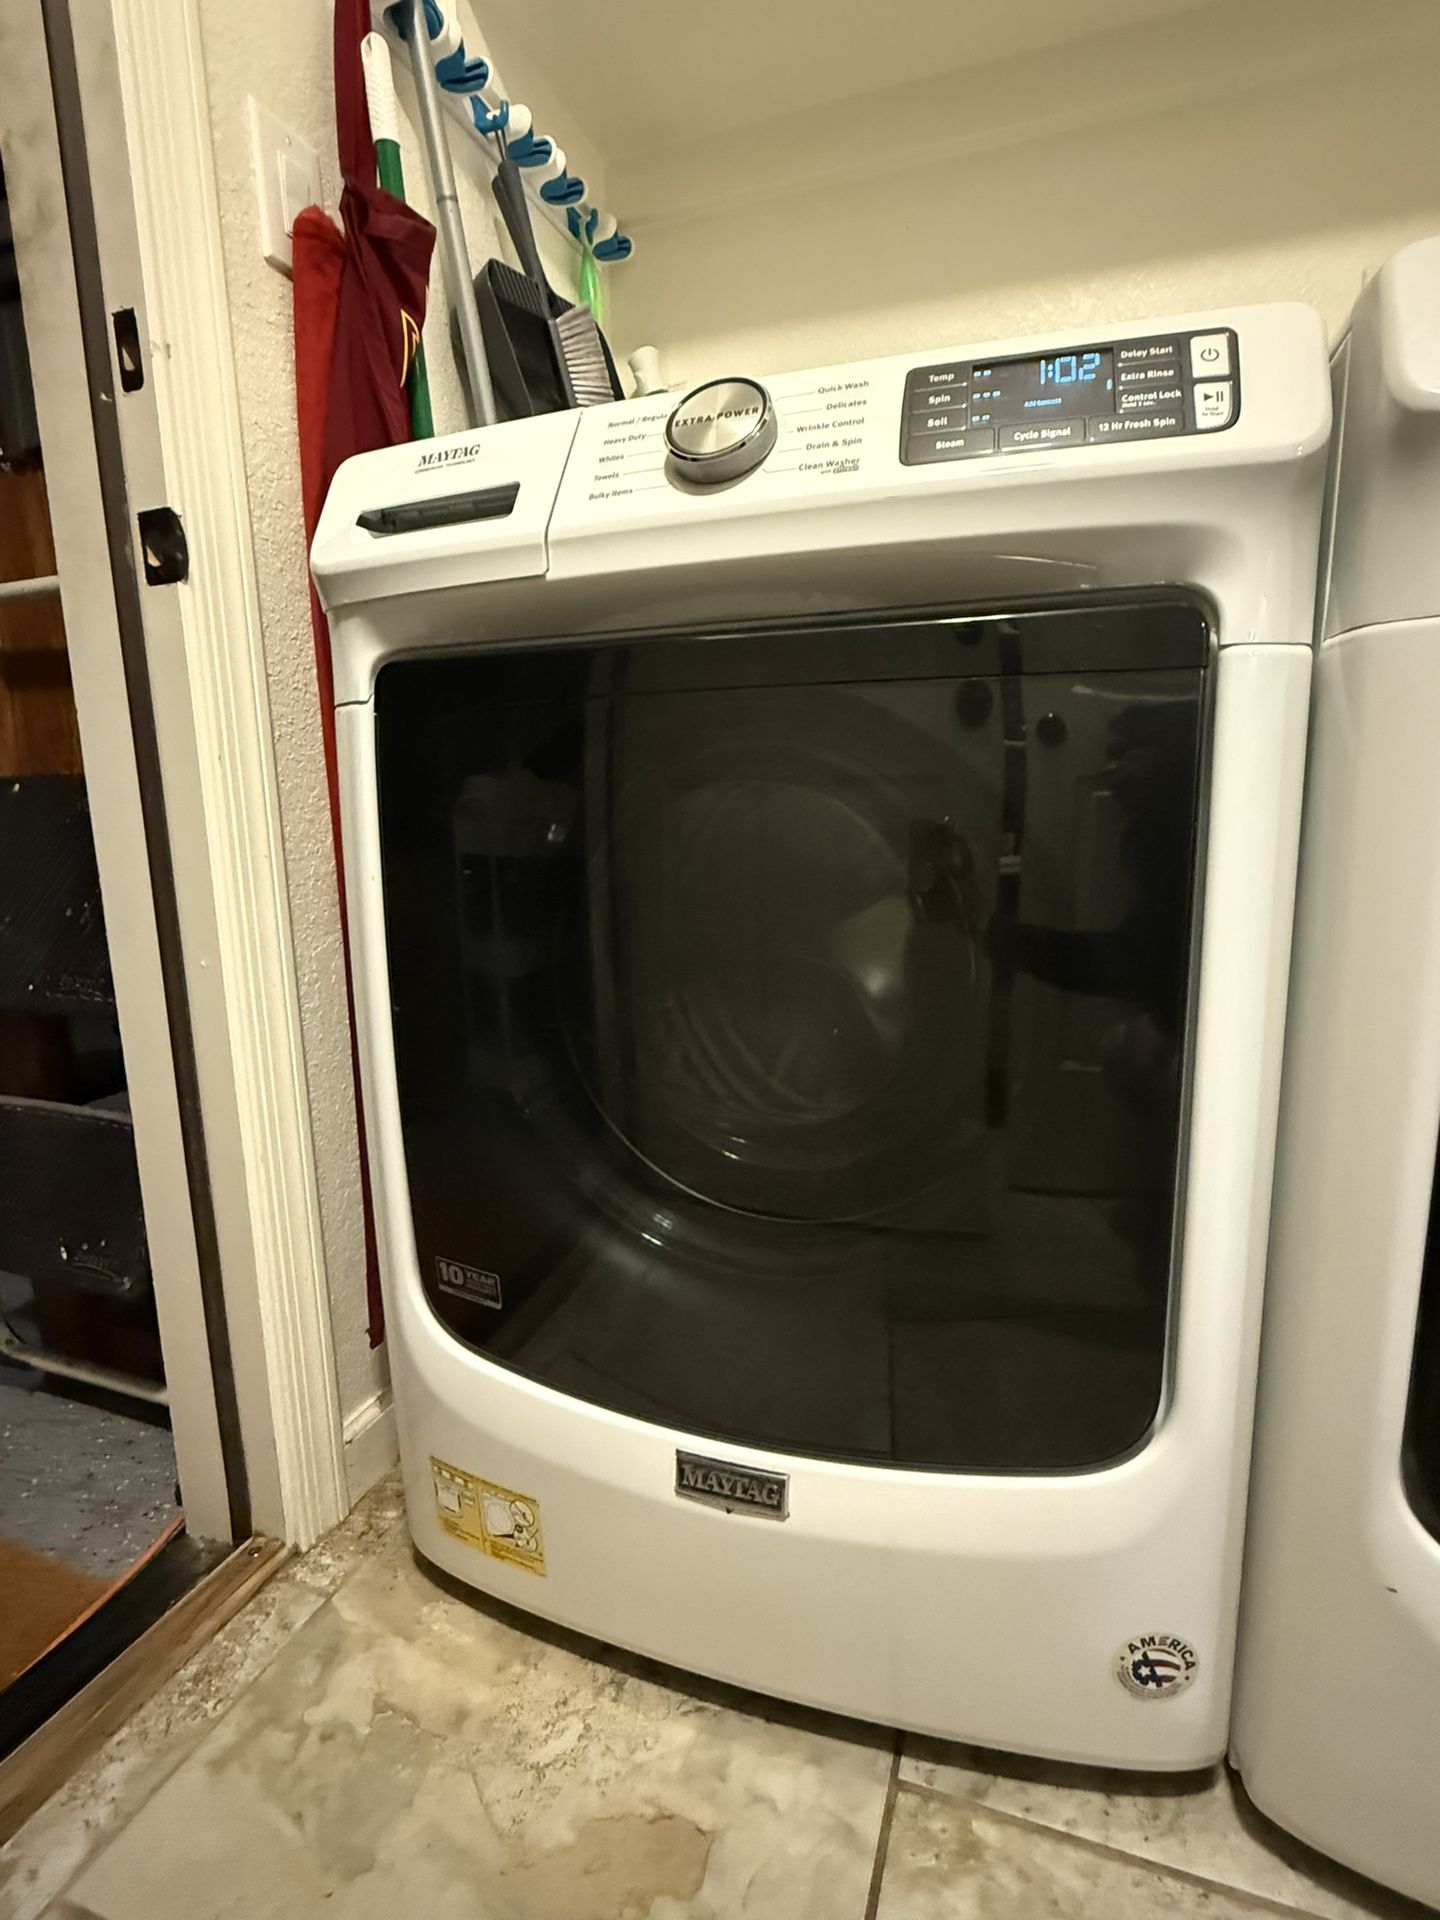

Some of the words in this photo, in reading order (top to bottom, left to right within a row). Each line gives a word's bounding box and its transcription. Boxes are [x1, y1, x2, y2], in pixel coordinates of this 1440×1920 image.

[1120, 349, 1147, 359] Delay
[1149, 346, 1173, 356] Start
[929, 373, 955, 383] Temp
[1120, 372, 1146, 381] Extra
[1147, 369, 1174, 379] Rinse
[818, 384, 842, 394] Quick
[845, 380, 869, 390] Wash
[928, 394, 951, 405] Spin
[1121, 391, 1157, 403] Control
[1158, 389, 1182, 399] Lock
[826, 400, 867, 411] Delicates
[607, 418, 635, 429] Normal
[641, 413, 668, 423] Regula
[674, 414, 712, 428] EXTRA
[716, 407, 760, 420] POWER
[927, 416, 948, 428] Soil
[796, 422, 830, 433] Wrinkle
[832, 417, 865, 428] Control
[1099, 422, 1110, 432] 12
[1111, 420, 1122, 431] Hr
[1124, 420, 1151, 430] Fresh
[1153, 417, 1176, 427] Spin
[603, 436, 627, 446] Heavy
[628, 433, 647, 443] Duty
[1013, 431, 1039, 442] Cycle
[1040, 427, 1071, 439] Signal
[806, 441, 830, 451] Drain
[842, 437, 862, 447] Spin
[935, 439, 965, 450] Steam
[418, 444, 480, 467] MAYTAG
[599, 454, 624, 464] Whites
[798, 462, 824, 471] Clean
[826, 458, 860, 468] Washer
[594, 472, 619, 482] Towels
[588, 491, 610, 500] Bulky
[611, 489, 633, 497] Items
[439, 1262, 464, 1285] 10
[681, 1464, 781, 1505] MAYTAG
[1127, 1636, 1196, 1671] AMERICA
